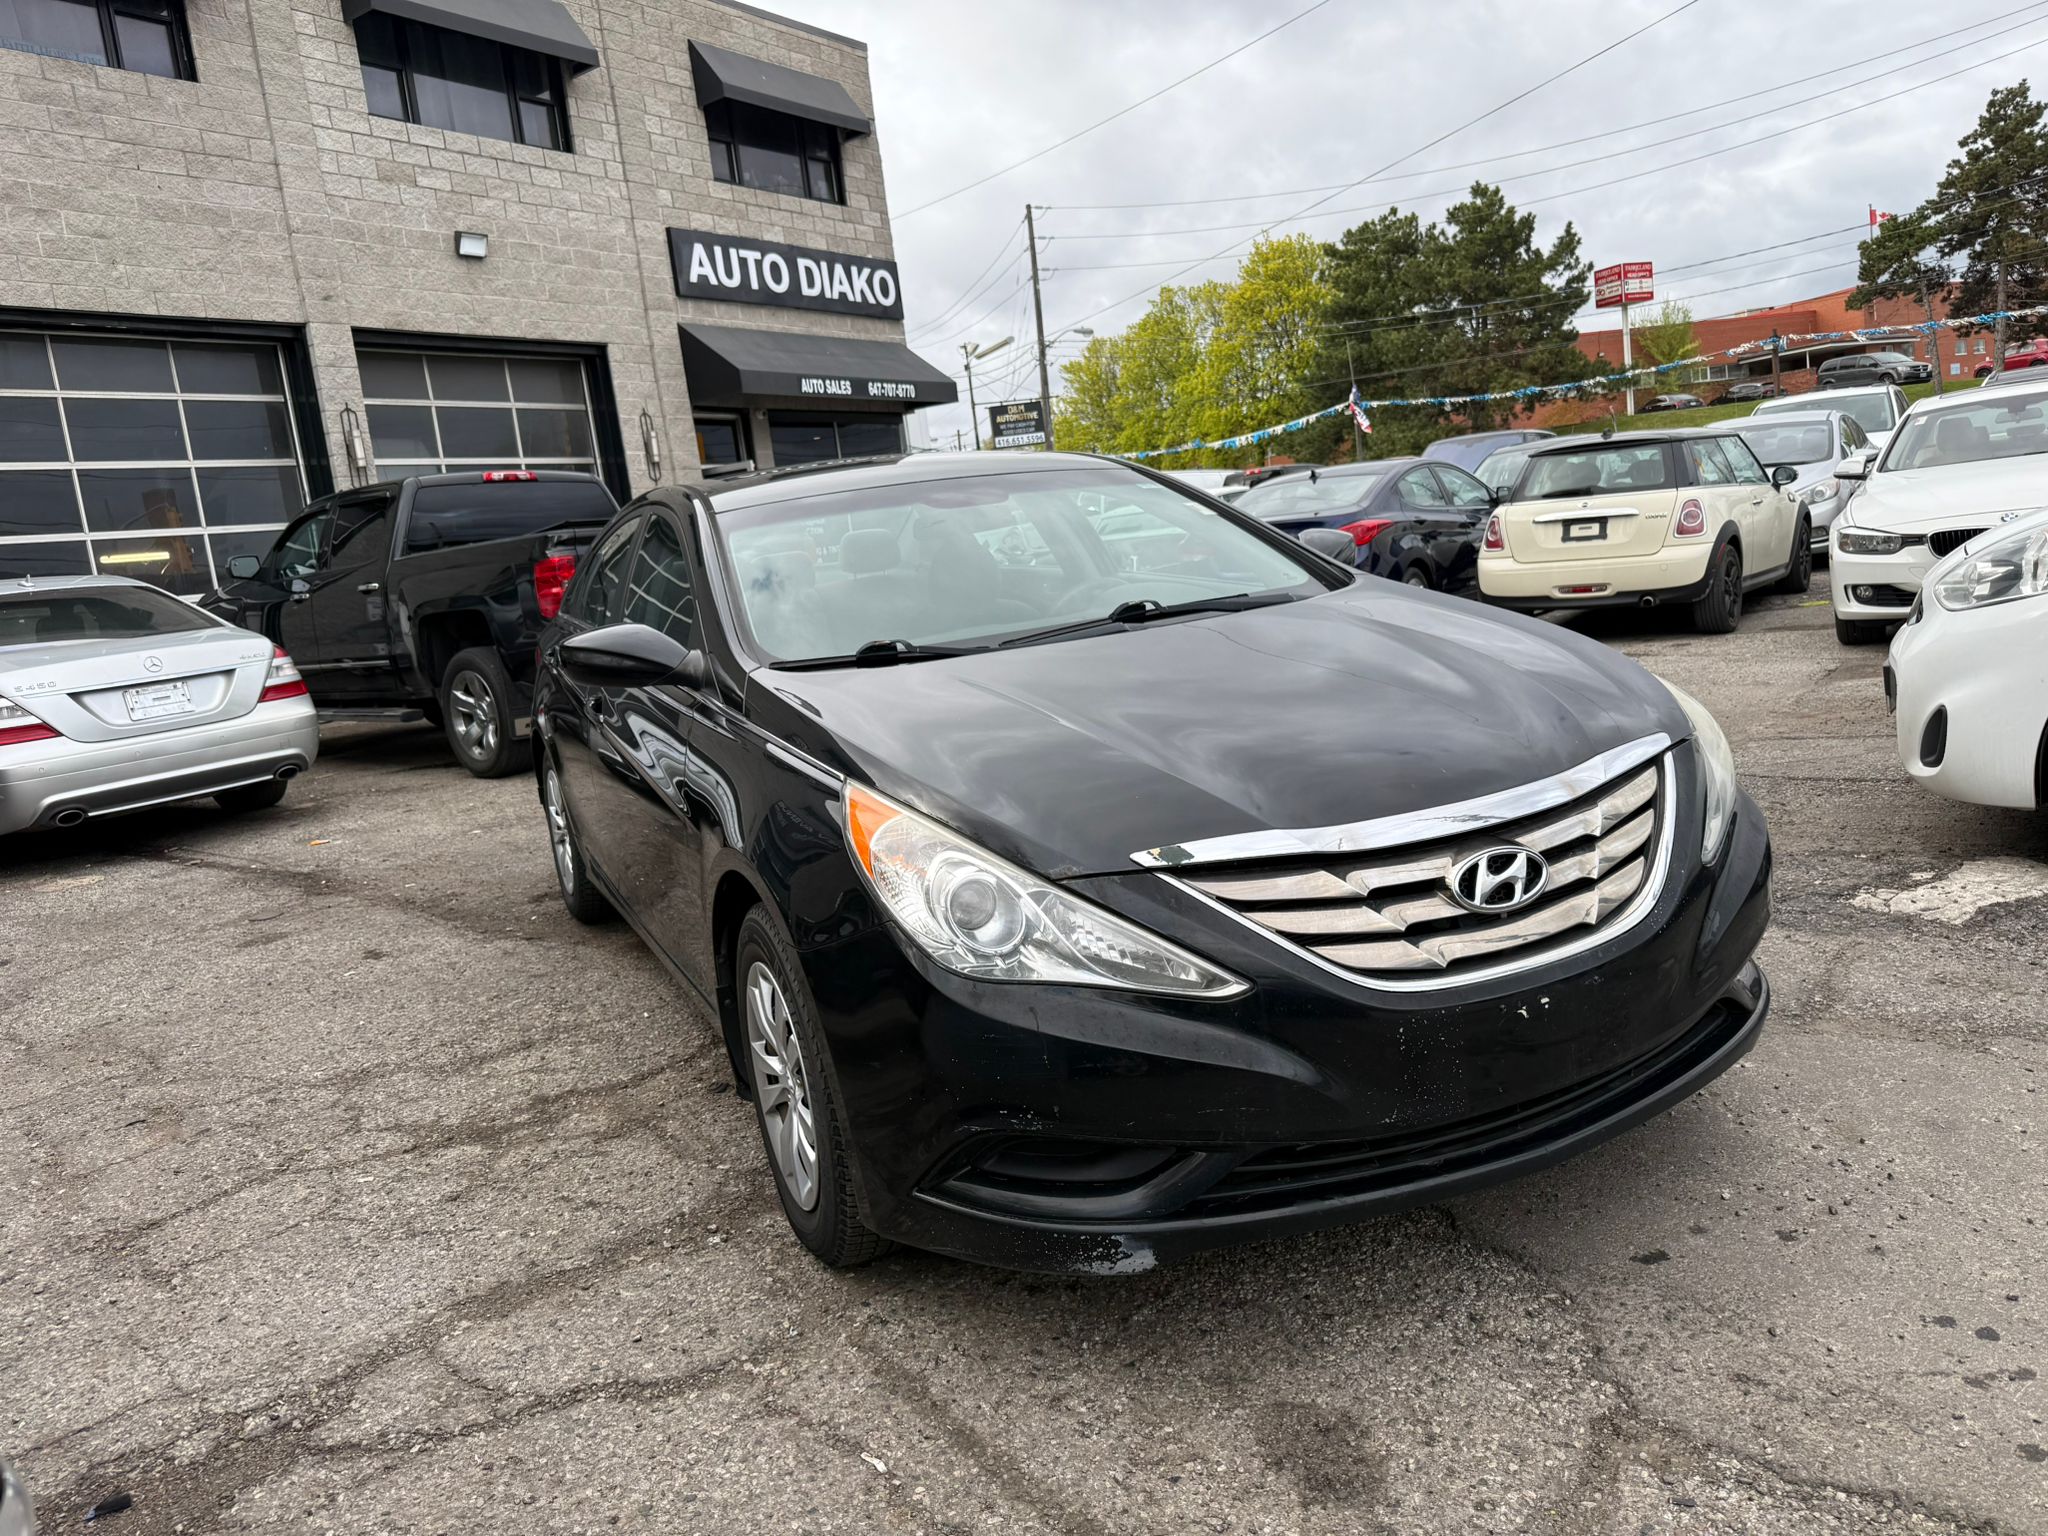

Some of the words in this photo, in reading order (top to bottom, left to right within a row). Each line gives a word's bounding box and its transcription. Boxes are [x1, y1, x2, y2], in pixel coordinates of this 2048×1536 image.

[689, 243, 790, 293] AUTO
[797, 257, 896, 307] DIAKO
[801, 378, 825, 394] AUTO
[825, 379, 852, 395] SALES
[996, 411, 1038, 423] AUTOMOTIVE
